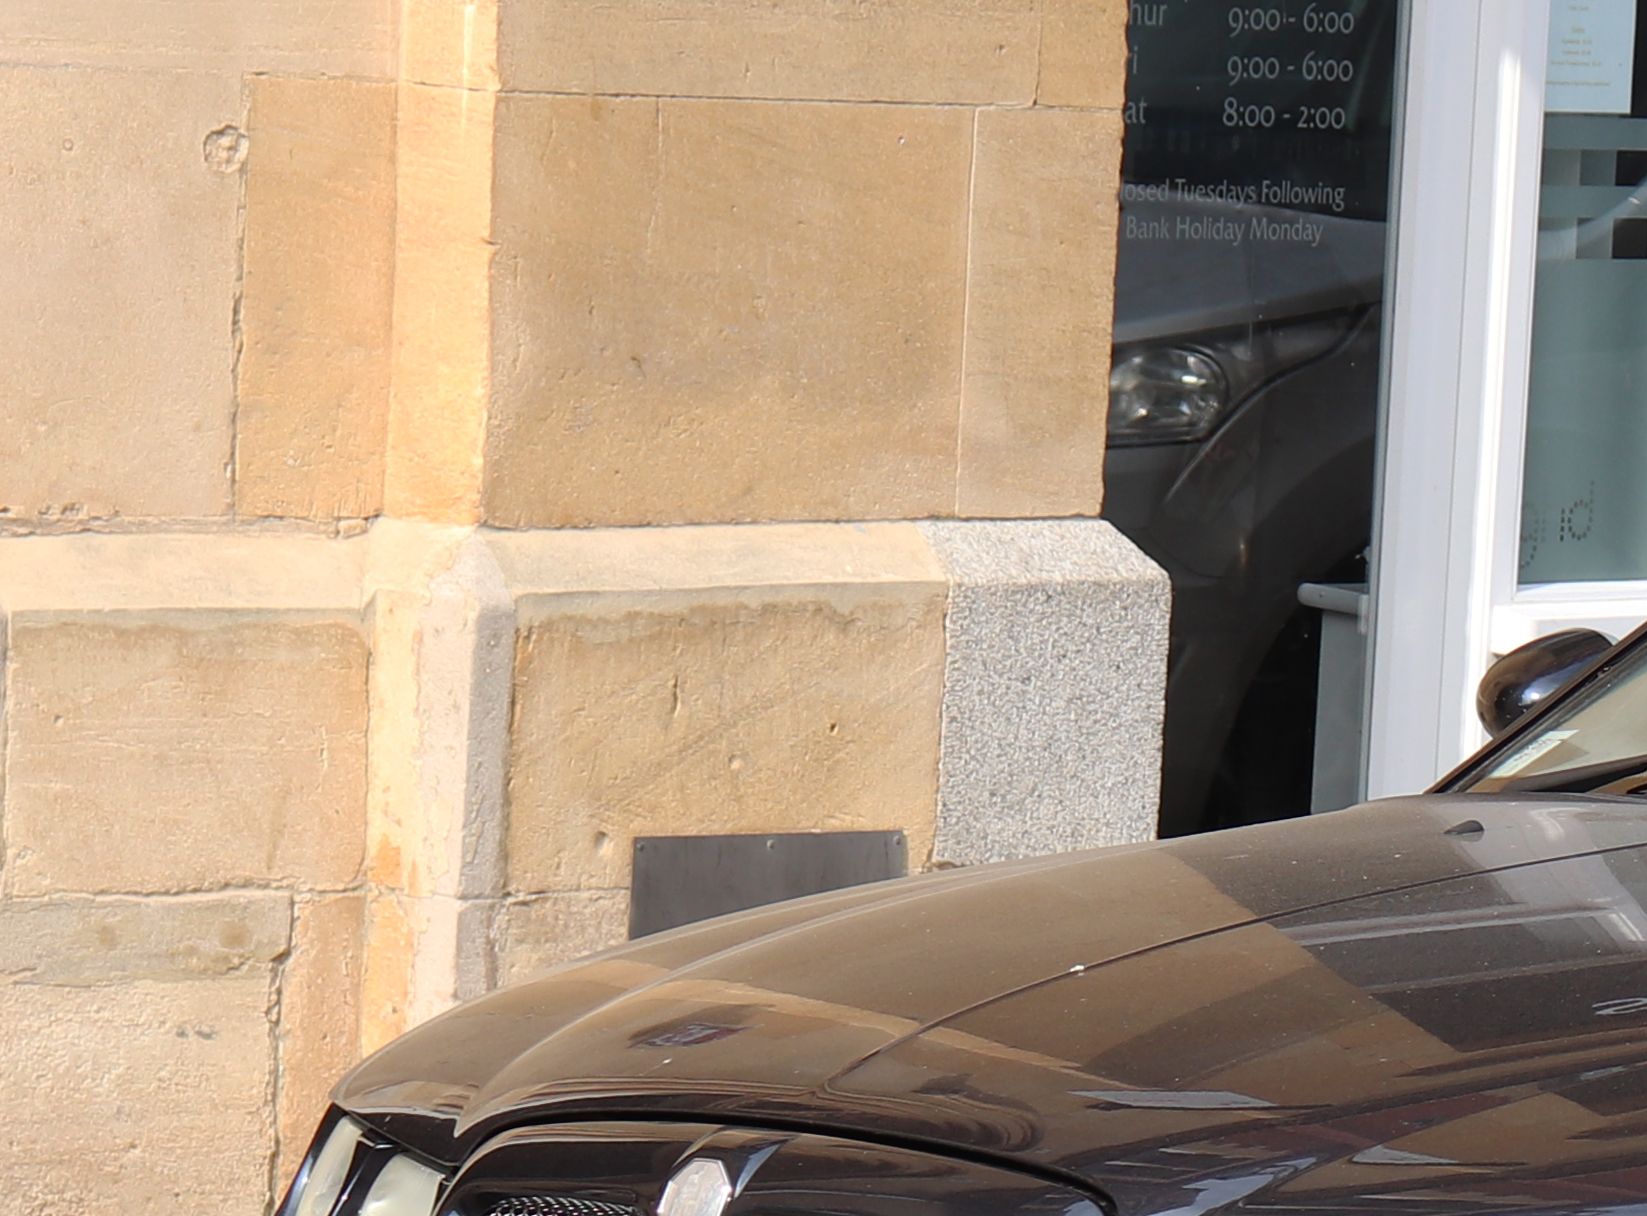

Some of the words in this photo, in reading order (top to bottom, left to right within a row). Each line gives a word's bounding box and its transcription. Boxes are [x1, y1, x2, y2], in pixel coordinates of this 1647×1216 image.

[1129, 0, 1167, 26] hur
[1228, 6, 1280, 38] 9:00
[1303, 2, 1354, 34] 6:00
[1227, 55, 1279, 87] 9:00
[1302, 50, 1353, 82] 6:00
[1124, 97, 1147, 125] at
[1222, 96, 1275, 127] 8:00
[1297, 106, 1345, 129] 2:00
[1120, 180, 1169, 202] losed
[1174, 178, 1256, 208] Tuesdays
[1261, 180, 1346, 212] Following
[1126, 215, 1170, 240] Bank
[1175, 215, 1246, 247] Holiday
[1249, 216, 1324, 247] Monday
